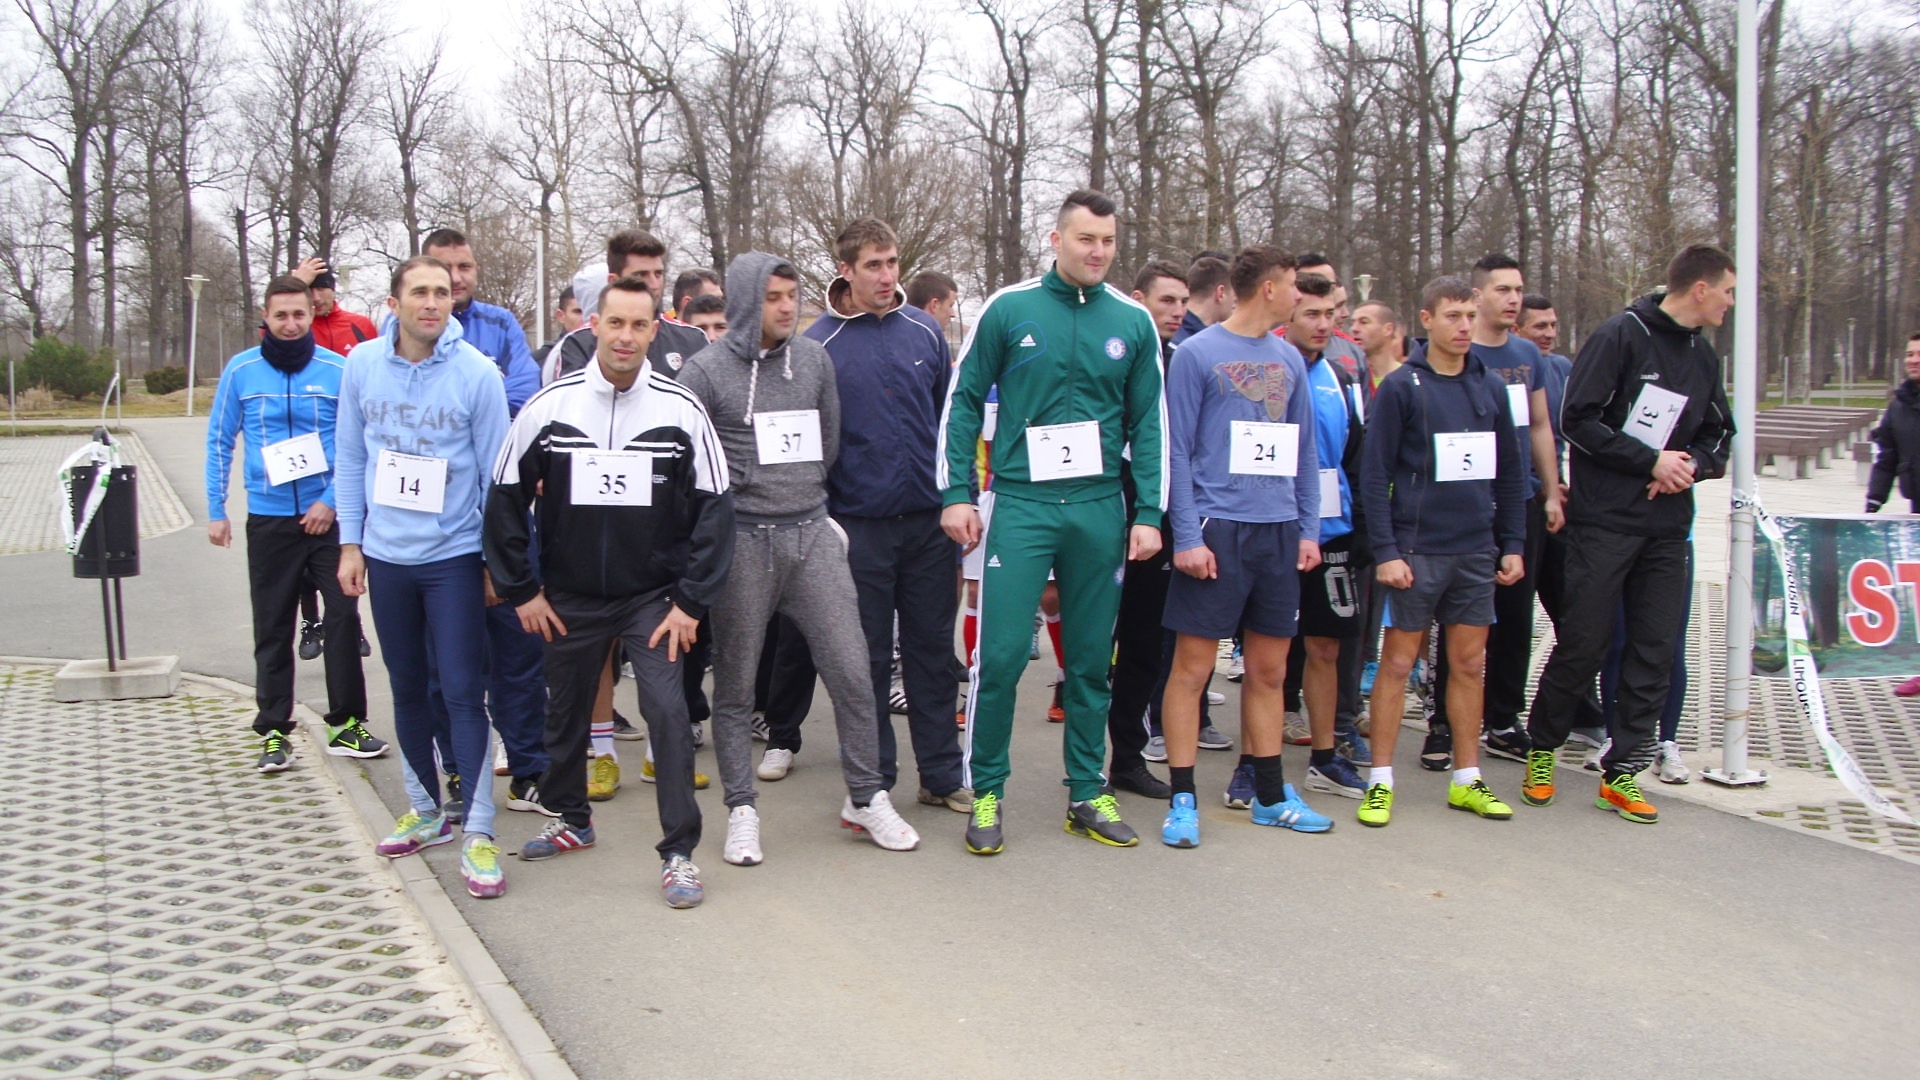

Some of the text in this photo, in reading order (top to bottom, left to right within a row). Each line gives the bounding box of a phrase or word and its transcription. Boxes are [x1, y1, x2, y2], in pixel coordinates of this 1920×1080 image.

[364, 399, 460, 432] BREAK
[1637, 406, 1659, 428] 31
[781, 433, 801, 453] 37
[1254, 443, 1276, 461] 24
[287, 454, 308, 472] 33
[1061, 446, 1072, 464] 2
[1462, 453, 1473, 471] 5
[399, 476, 421, 496] 14
[598, 474, 627, 495] 35
